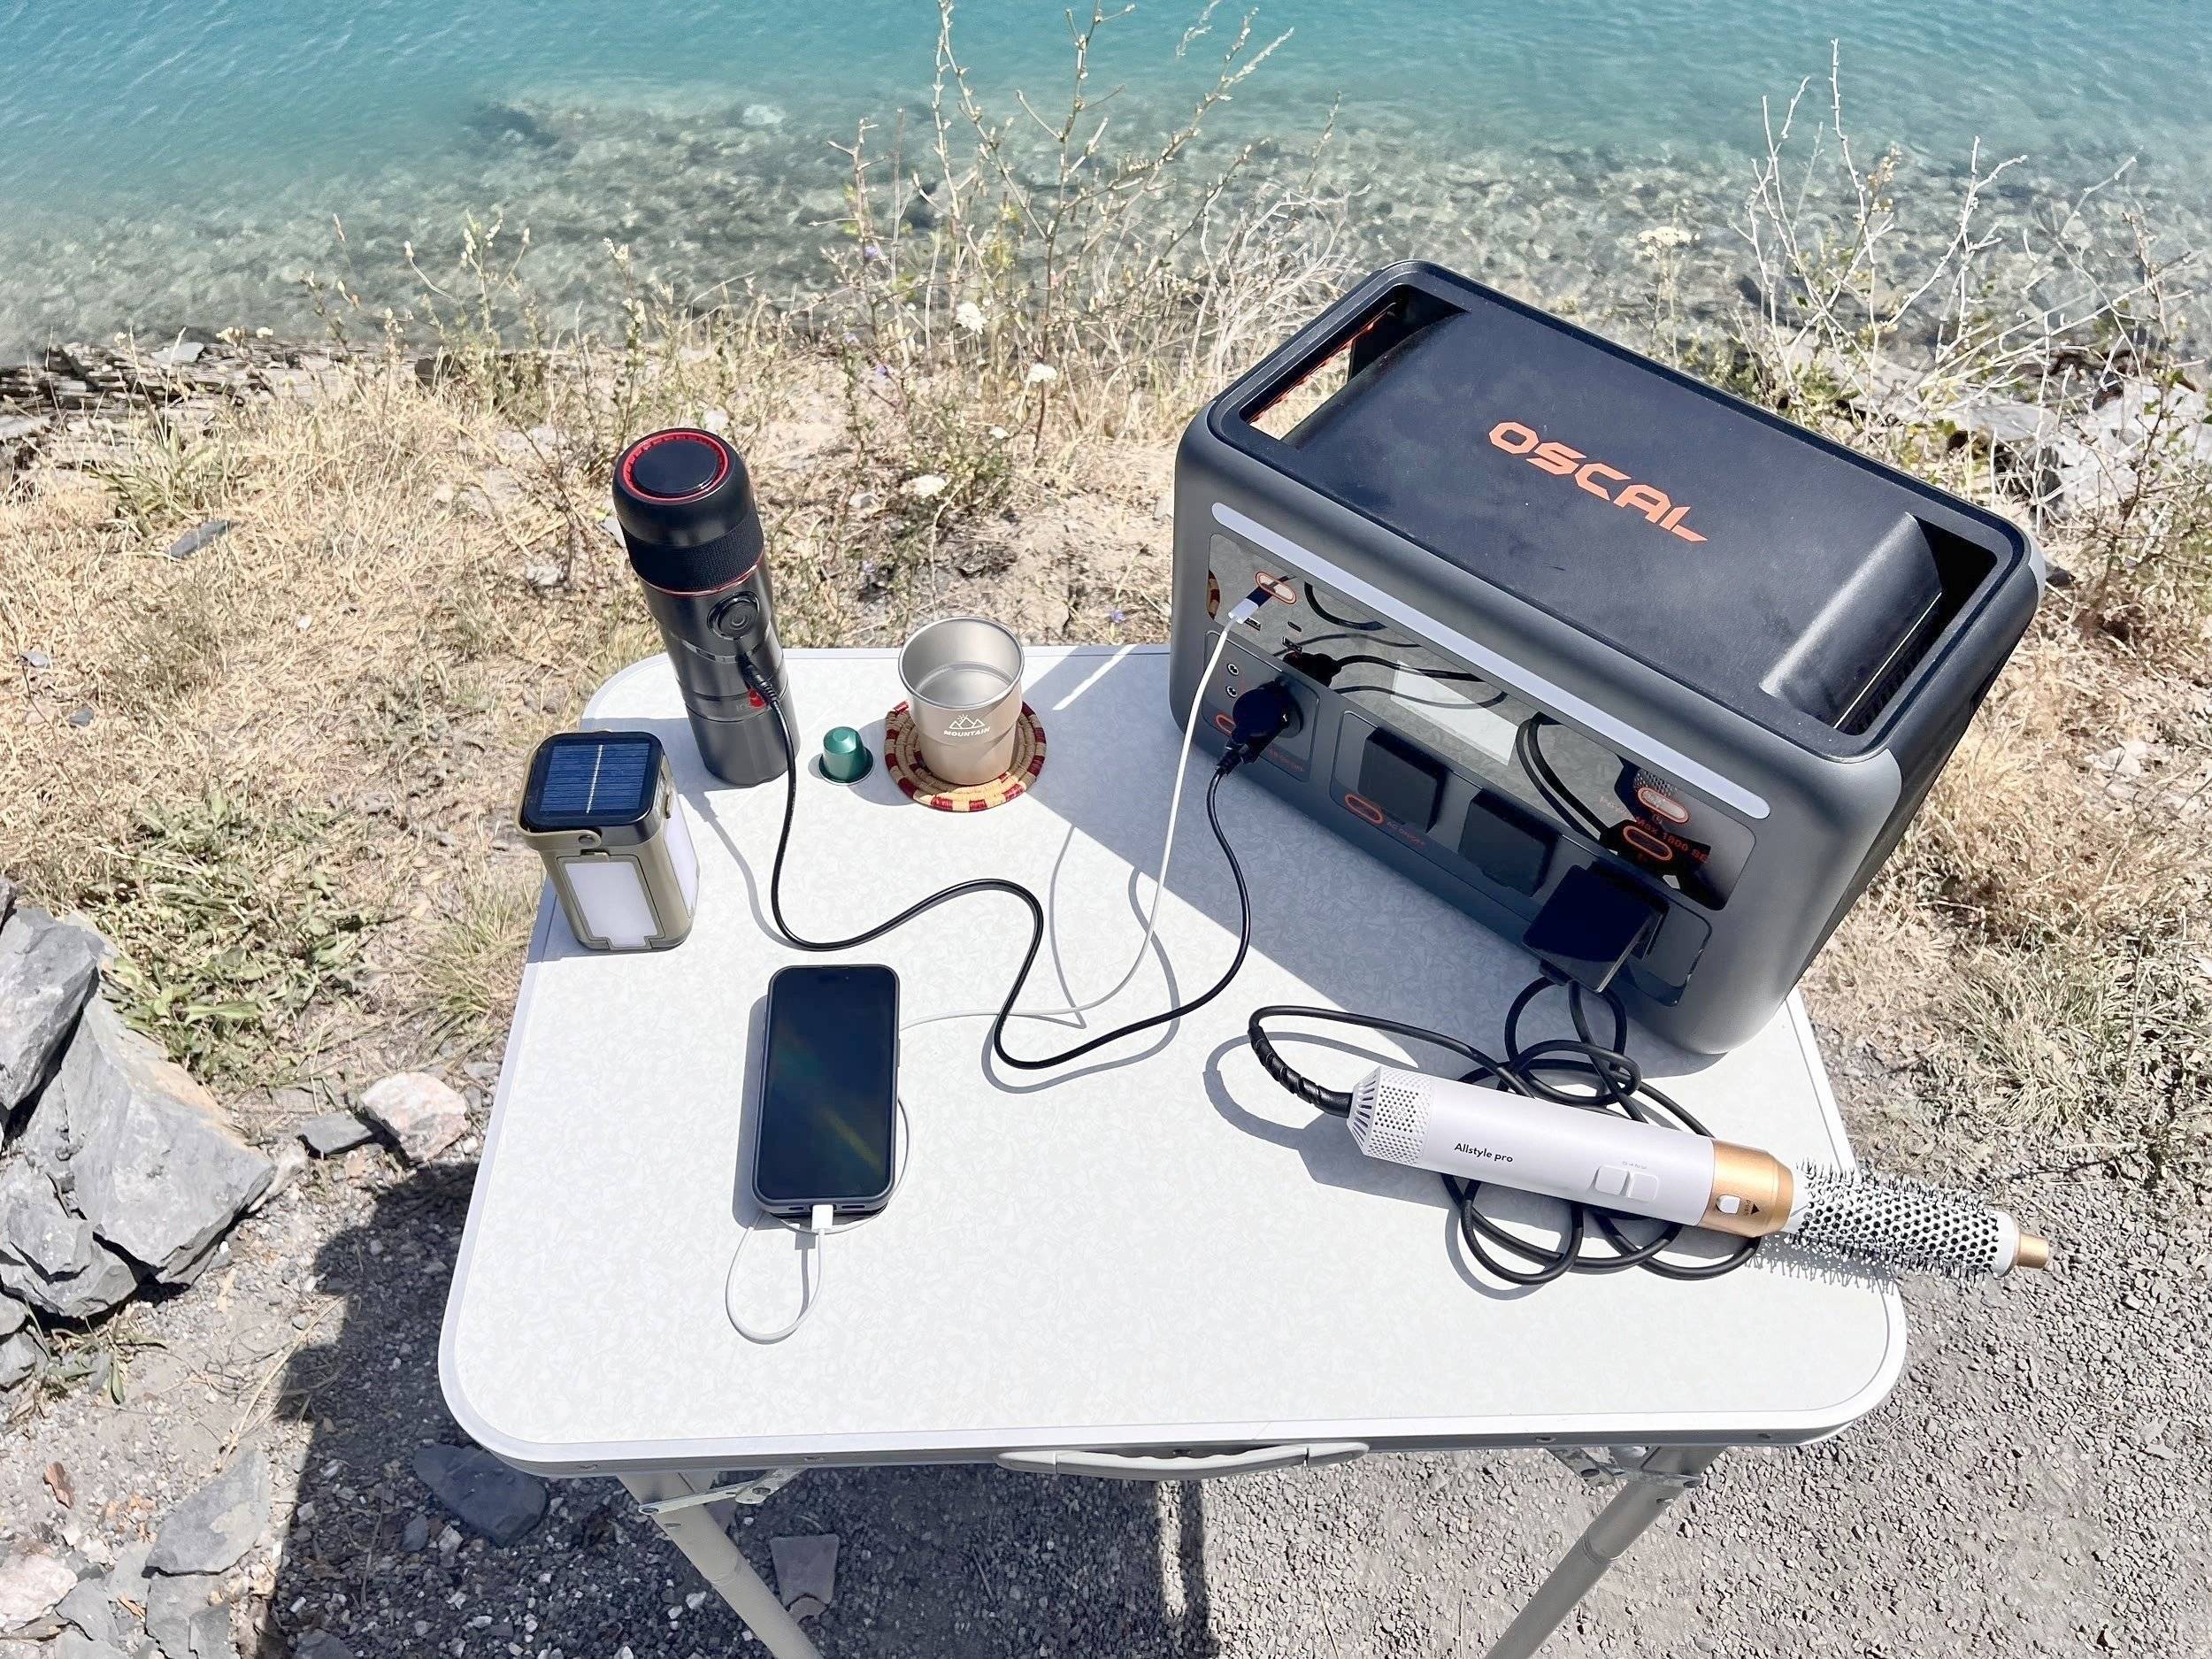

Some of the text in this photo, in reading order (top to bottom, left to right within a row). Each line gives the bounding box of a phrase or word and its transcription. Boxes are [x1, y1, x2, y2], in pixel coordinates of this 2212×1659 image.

[1489, 421, 1708, 542] OSCAL
[943, 726, 991, 737] MOUNTAIN
[1454, 1142, 1514, 1163] Allstyle pro
